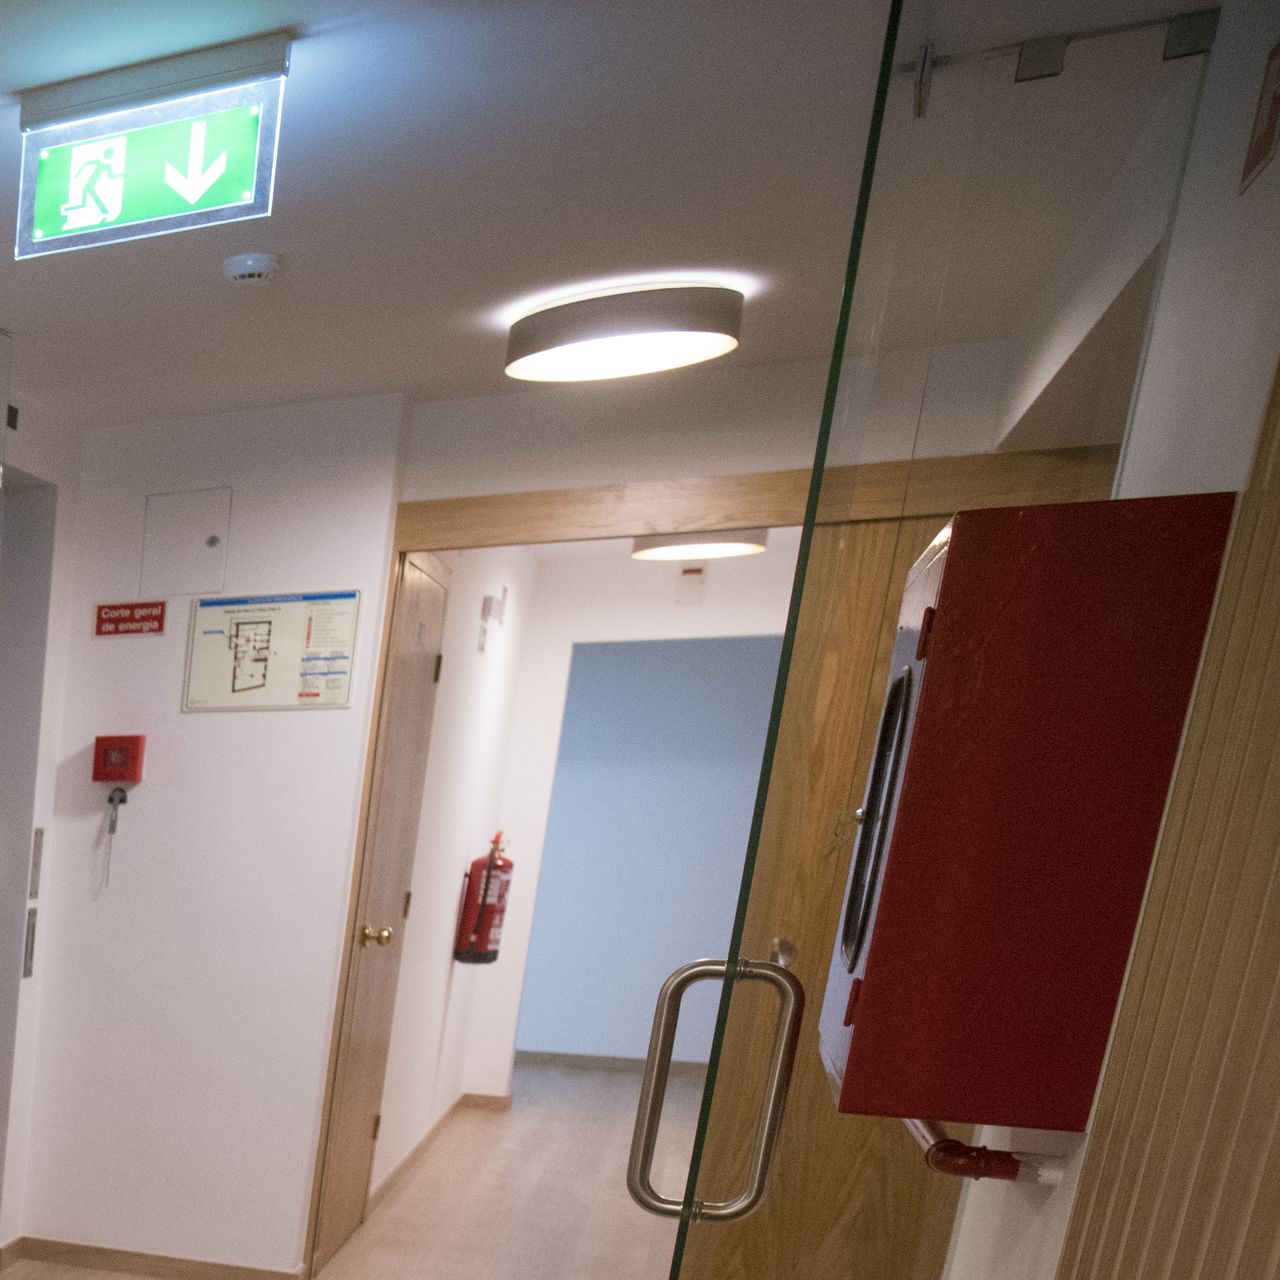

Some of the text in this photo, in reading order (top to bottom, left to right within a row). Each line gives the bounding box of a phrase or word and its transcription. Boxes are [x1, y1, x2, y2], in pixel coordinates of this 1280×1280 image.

[101, 605, 162, 619] Corte geral
[101, 619, 159, 632] de energia
